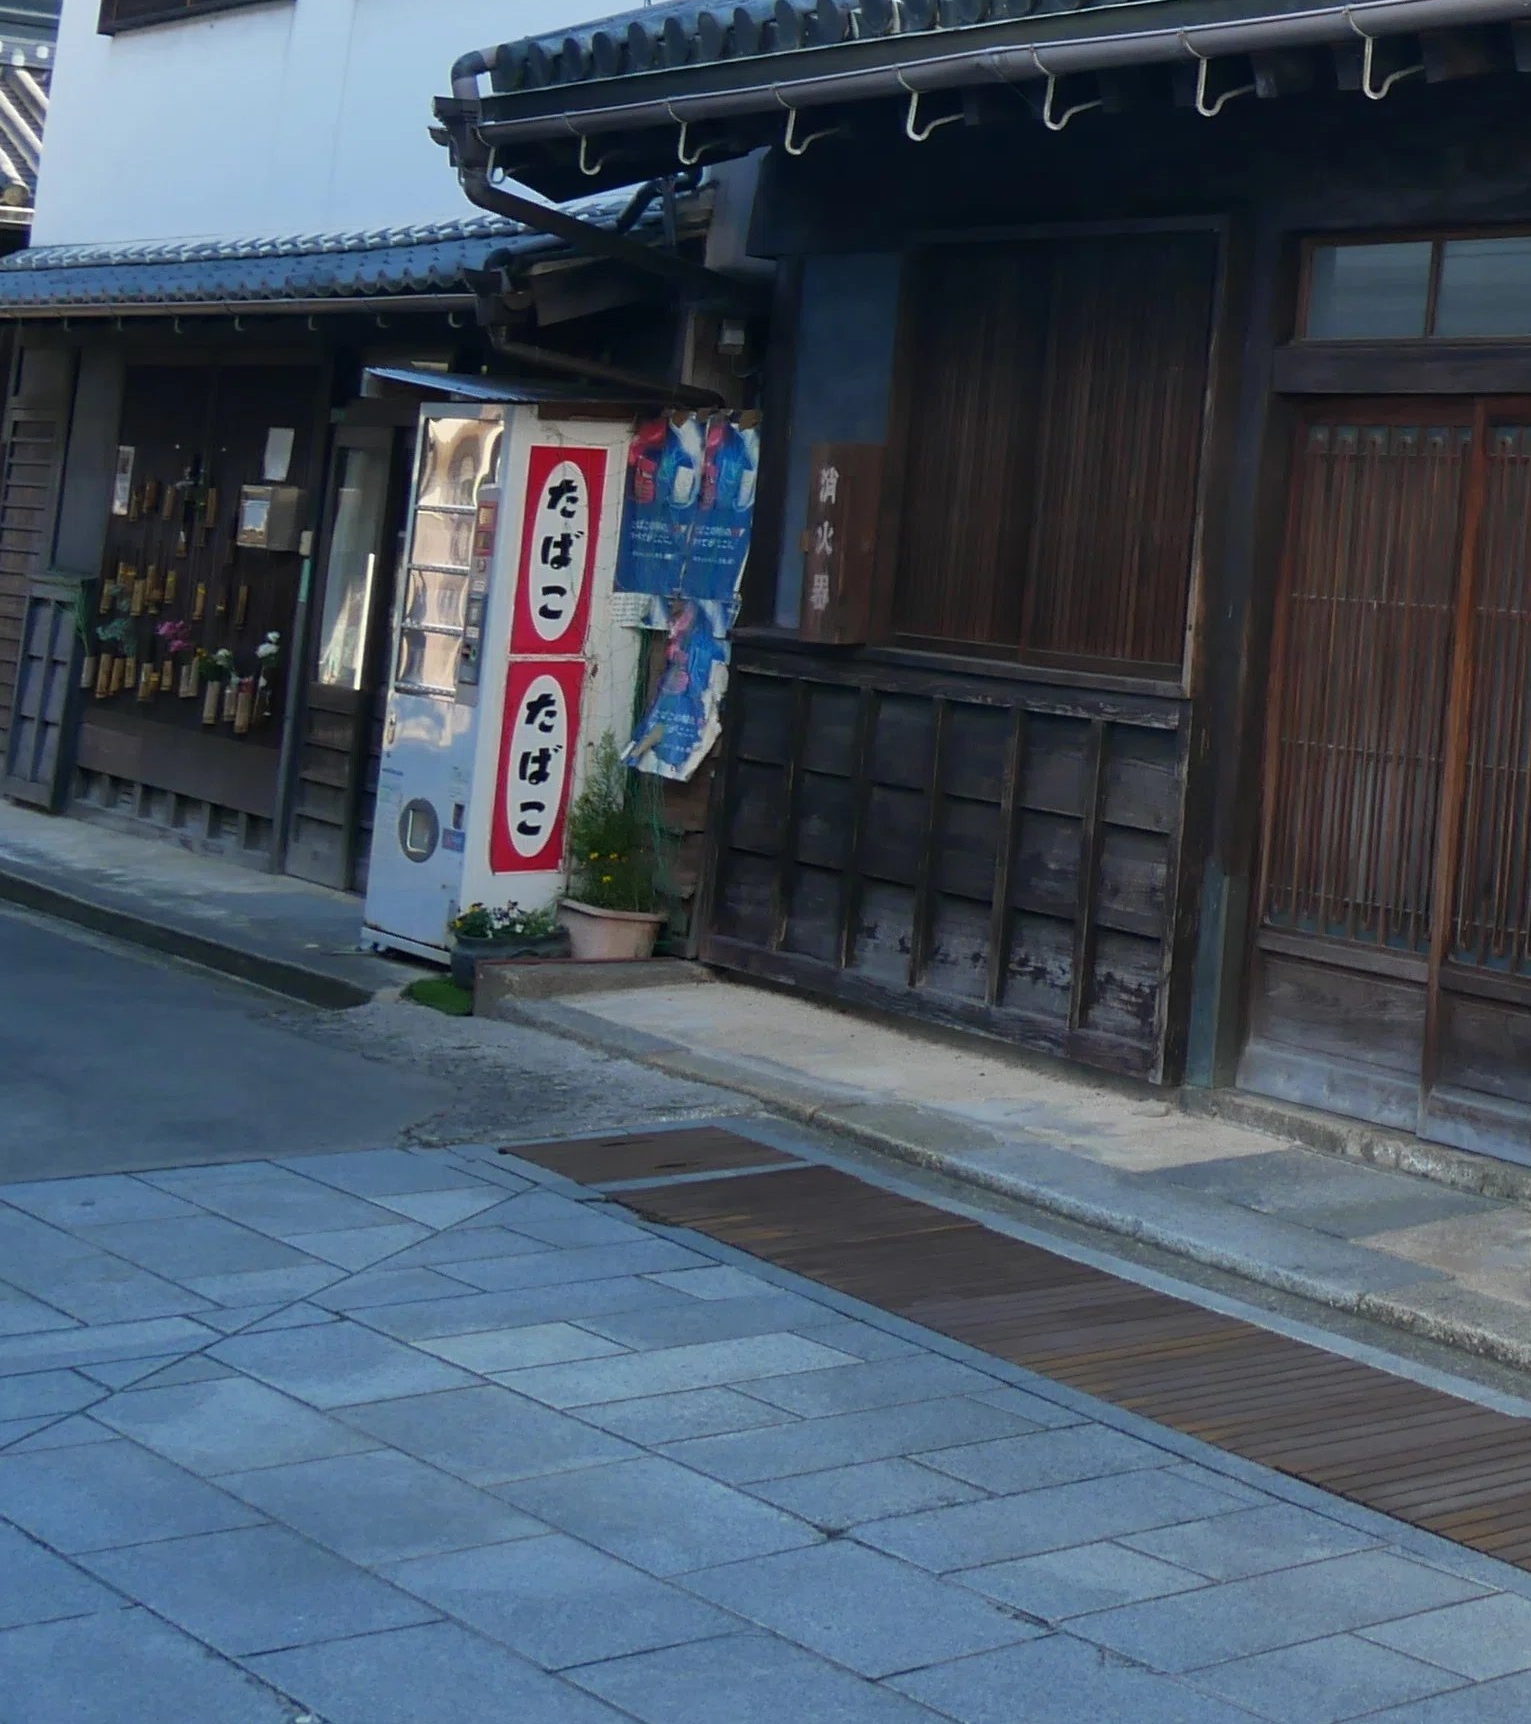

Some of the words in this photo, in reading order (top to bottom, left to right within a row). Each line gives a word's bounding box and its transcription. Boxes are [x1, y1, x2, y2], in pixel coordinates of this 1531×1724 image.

[539, 478, 585, 620] たばこ
[810, 466, 840, 611] 消火器
[517, 693, 564, 836] たばこ
